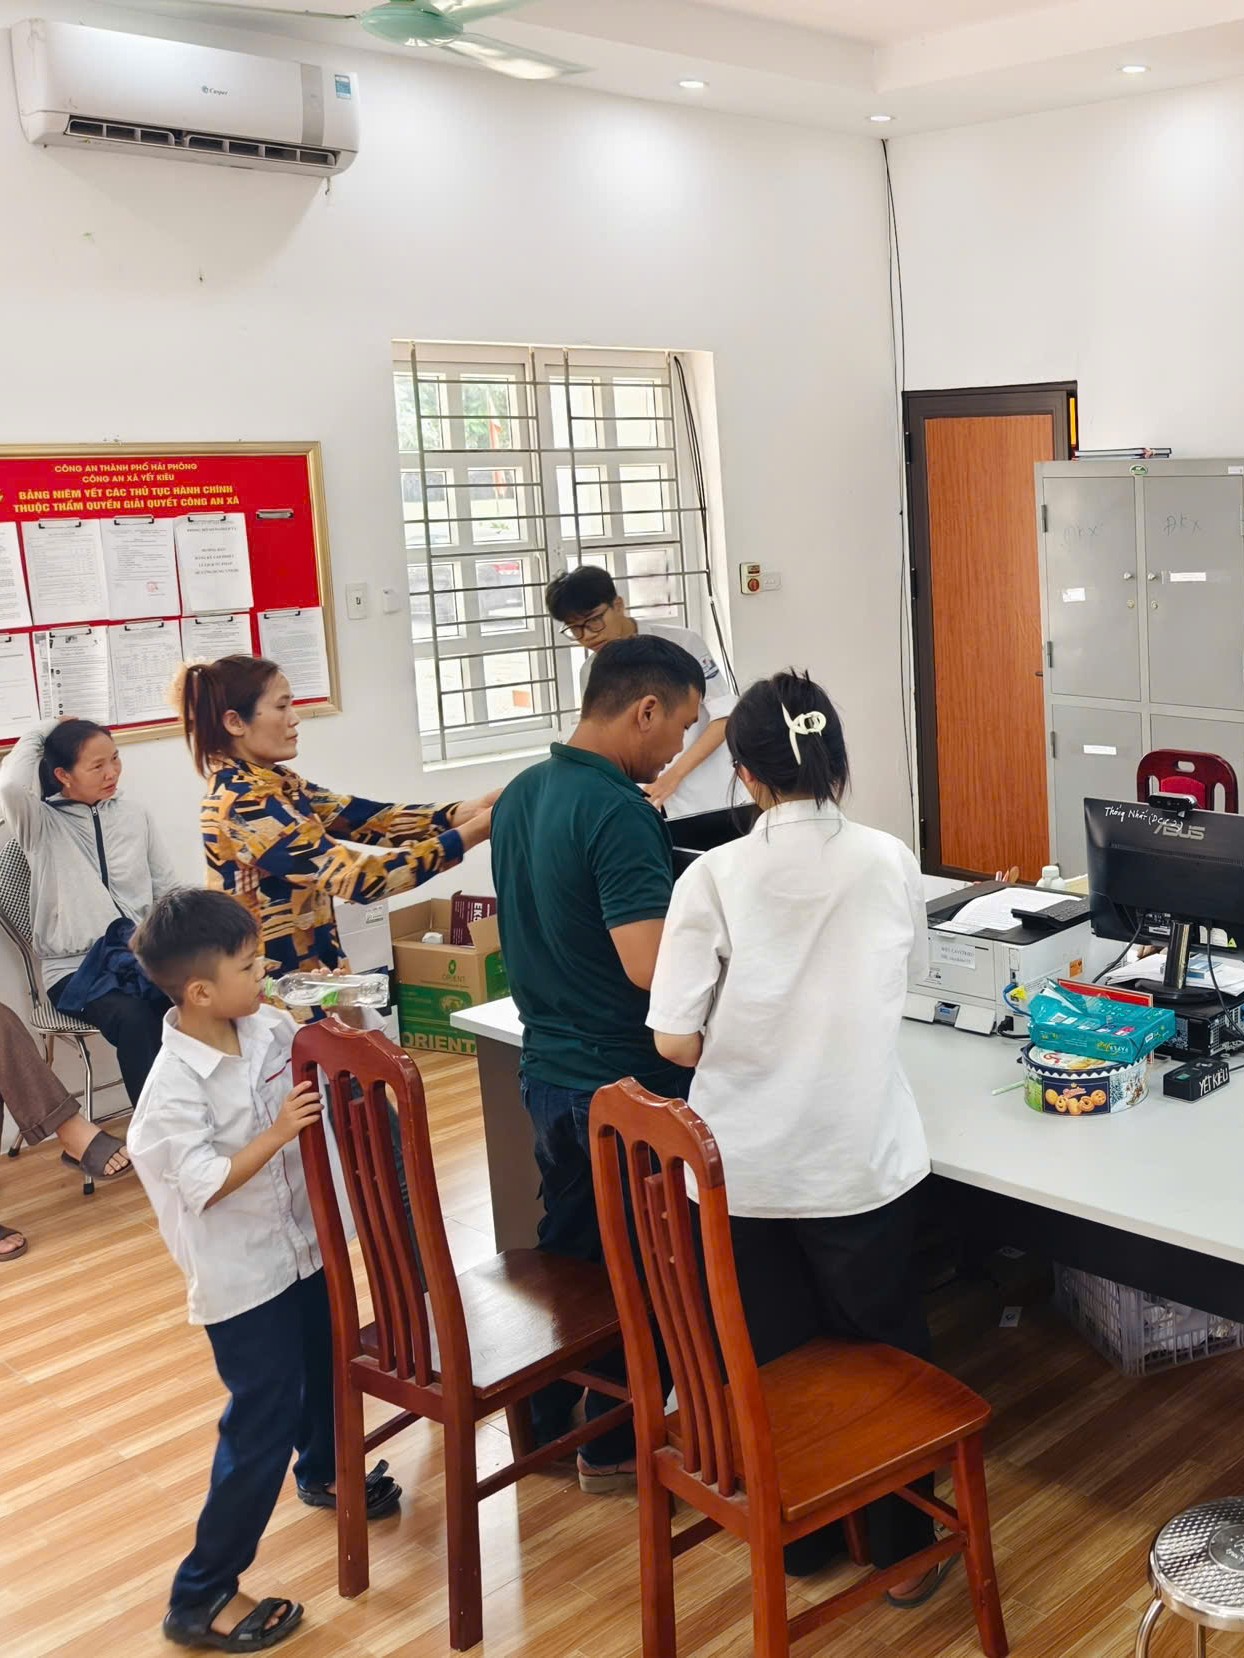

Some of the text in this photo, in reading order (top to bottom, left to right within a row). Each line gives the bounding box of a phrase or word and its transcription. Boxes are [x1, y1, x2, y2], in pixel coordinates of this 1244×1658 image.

[55, 464, 82, 472] CÔNG
[99, 463, 128, 472] THÀNH
[131, 462, 149, 471] PHỐ
[168, 462, 197, 470] PHÒNG
[82, 474, 109, 483] CÔNG
[127, 473, 138, 481] XÃ
[141, 472, 154, 481] YẾT
[157, 473, 174, 481] KIÊU
[53, 489, 81, 499] NIÊM
[84, 487, 102, 498] YẾT
[106, 487, 126, 497] CÁC
[130, 485, 149, 496] THỦ
[151, 487, 171, 496] TỤC
[173, 486, 200, 495] HÀNH
[203, 484, 233, 494] CHÍNH
[13, 503, 50, 513] THUỘC
[52, 500, 83, 511] THẨM
[86, 499, 120, 510] QUYỀN
[147, 496, 178, 508] QUYẾT
[180, 497, 208, 506] CÔNG
[210, 497, 224, 505] AN
[226, 496, 240, 505] XÃ
[1153, 822, 1205, 840] ASUS
[401, 1031, 477, 1055] ORIENT
